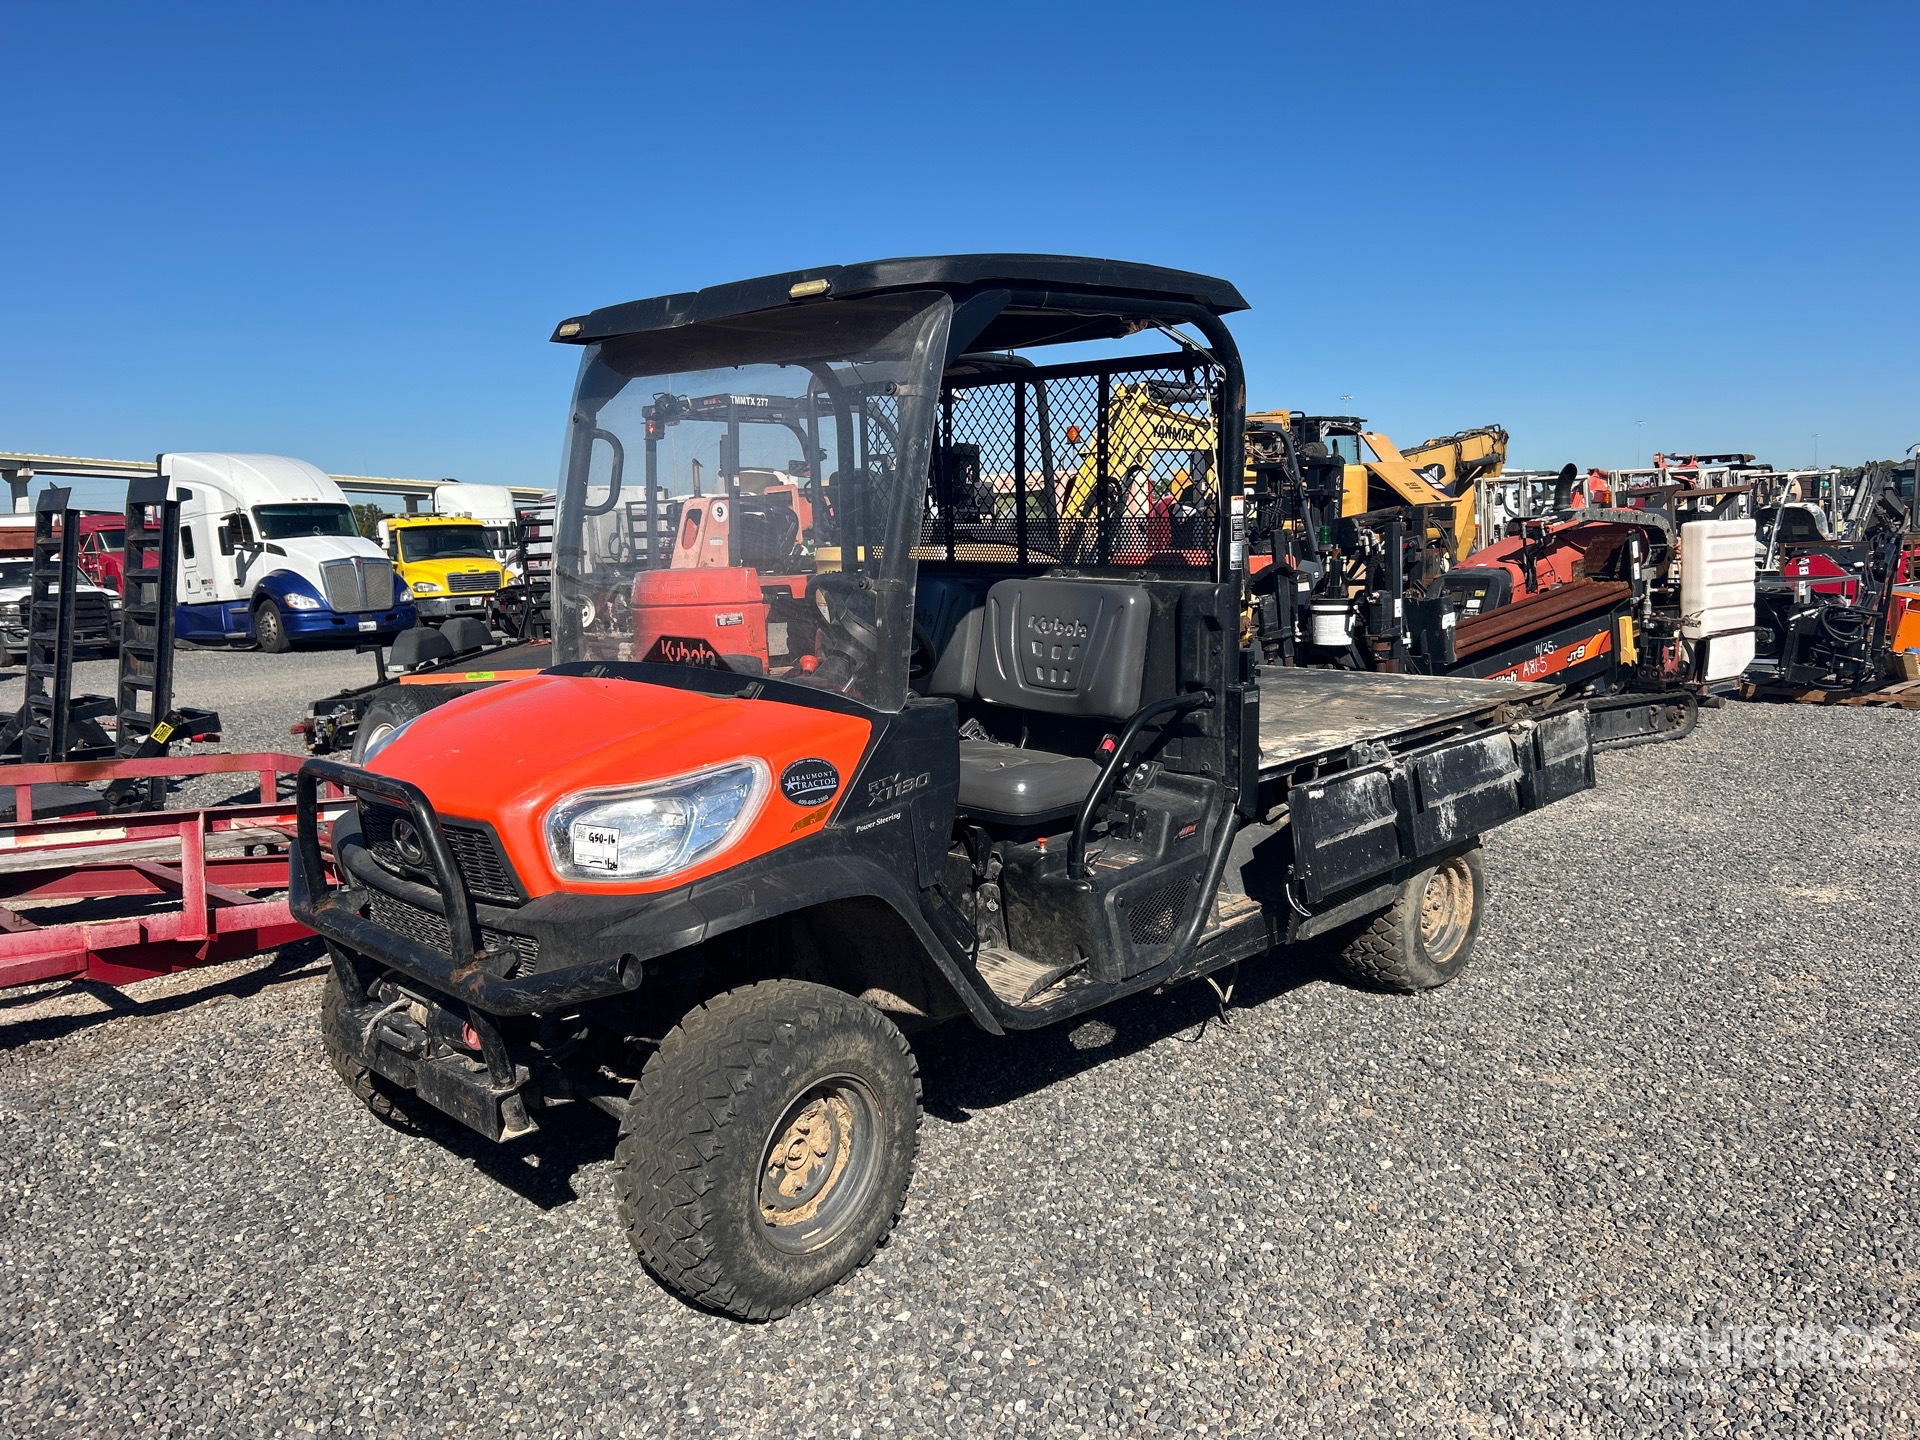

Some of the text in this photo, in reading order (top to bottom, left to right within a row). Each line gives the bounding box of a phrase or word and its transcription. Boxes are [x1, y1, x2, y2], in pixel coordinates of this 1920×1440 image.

[730, 395, 755, 406] TMMTX
[757, 398, 769, 407] 277
[717, 506, 724, 517] 9
[1027, 615, 1087, 638] Kubota
[661, 639, 718, 667] Kubota
[1567, 645, 1586, 662] JT9
[791, 770, 833, 782] BEAUMONT
[796, 777, 837, 790] TRACTOR
[868, 772, 900, 792] RTV
[855, 812, 901, 834] Power Steering
